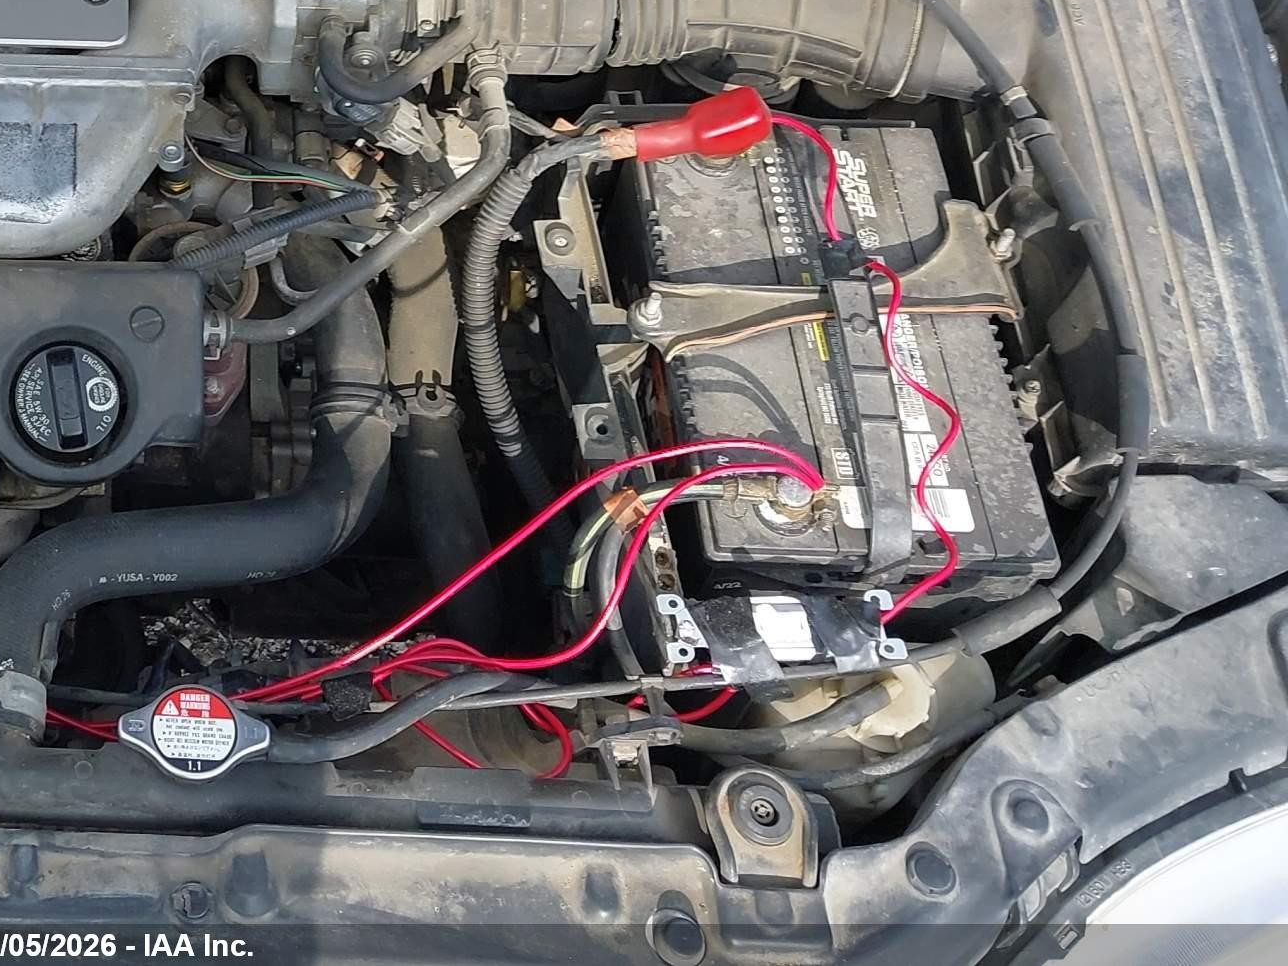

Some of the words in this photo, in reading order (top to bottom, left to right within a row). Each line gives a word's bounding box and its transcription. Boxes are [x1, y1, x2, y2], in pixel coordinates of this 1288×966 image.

[833, 148, 864, 220] START
[852, 156, 875, 221] SUPER
[25, 381, 35, 414] SERVICE
[82, 354, 107, 377] ENGINE
[96, 415, 112, 432] OIL
[116, 573, 144, 583] YUSA
[153, 573, 178, 582] Y002
[180, 693, 210, 702] DANGER
[180, 702, 210, 710] WARNING
[187, 761, 202, 771] 1.1
